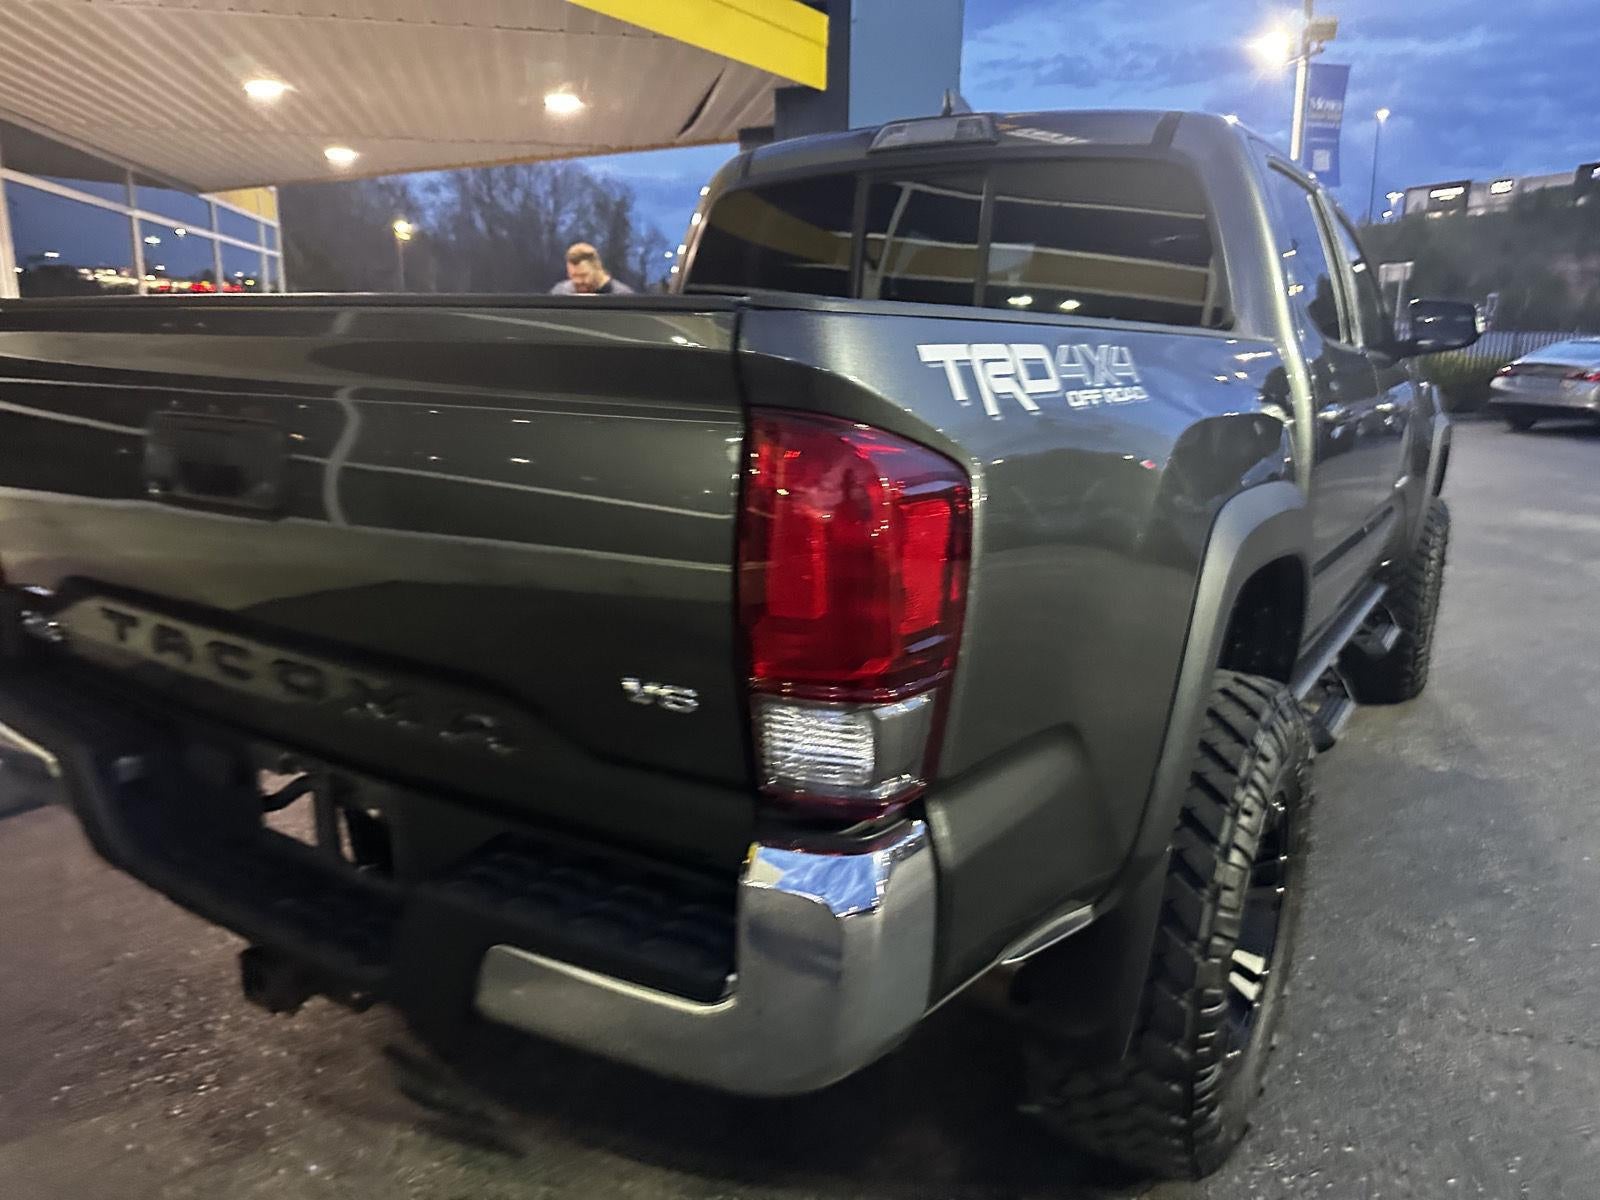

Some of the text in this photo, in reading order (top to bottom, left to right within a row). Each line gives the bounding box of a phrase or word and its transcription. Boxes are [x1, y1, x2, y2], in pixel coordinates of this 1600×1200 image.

[917, 343, 1061, 416] TRD
[1066, 386, 1149, 407] OFF ROAD
[620, 677, 699, 713] V6
